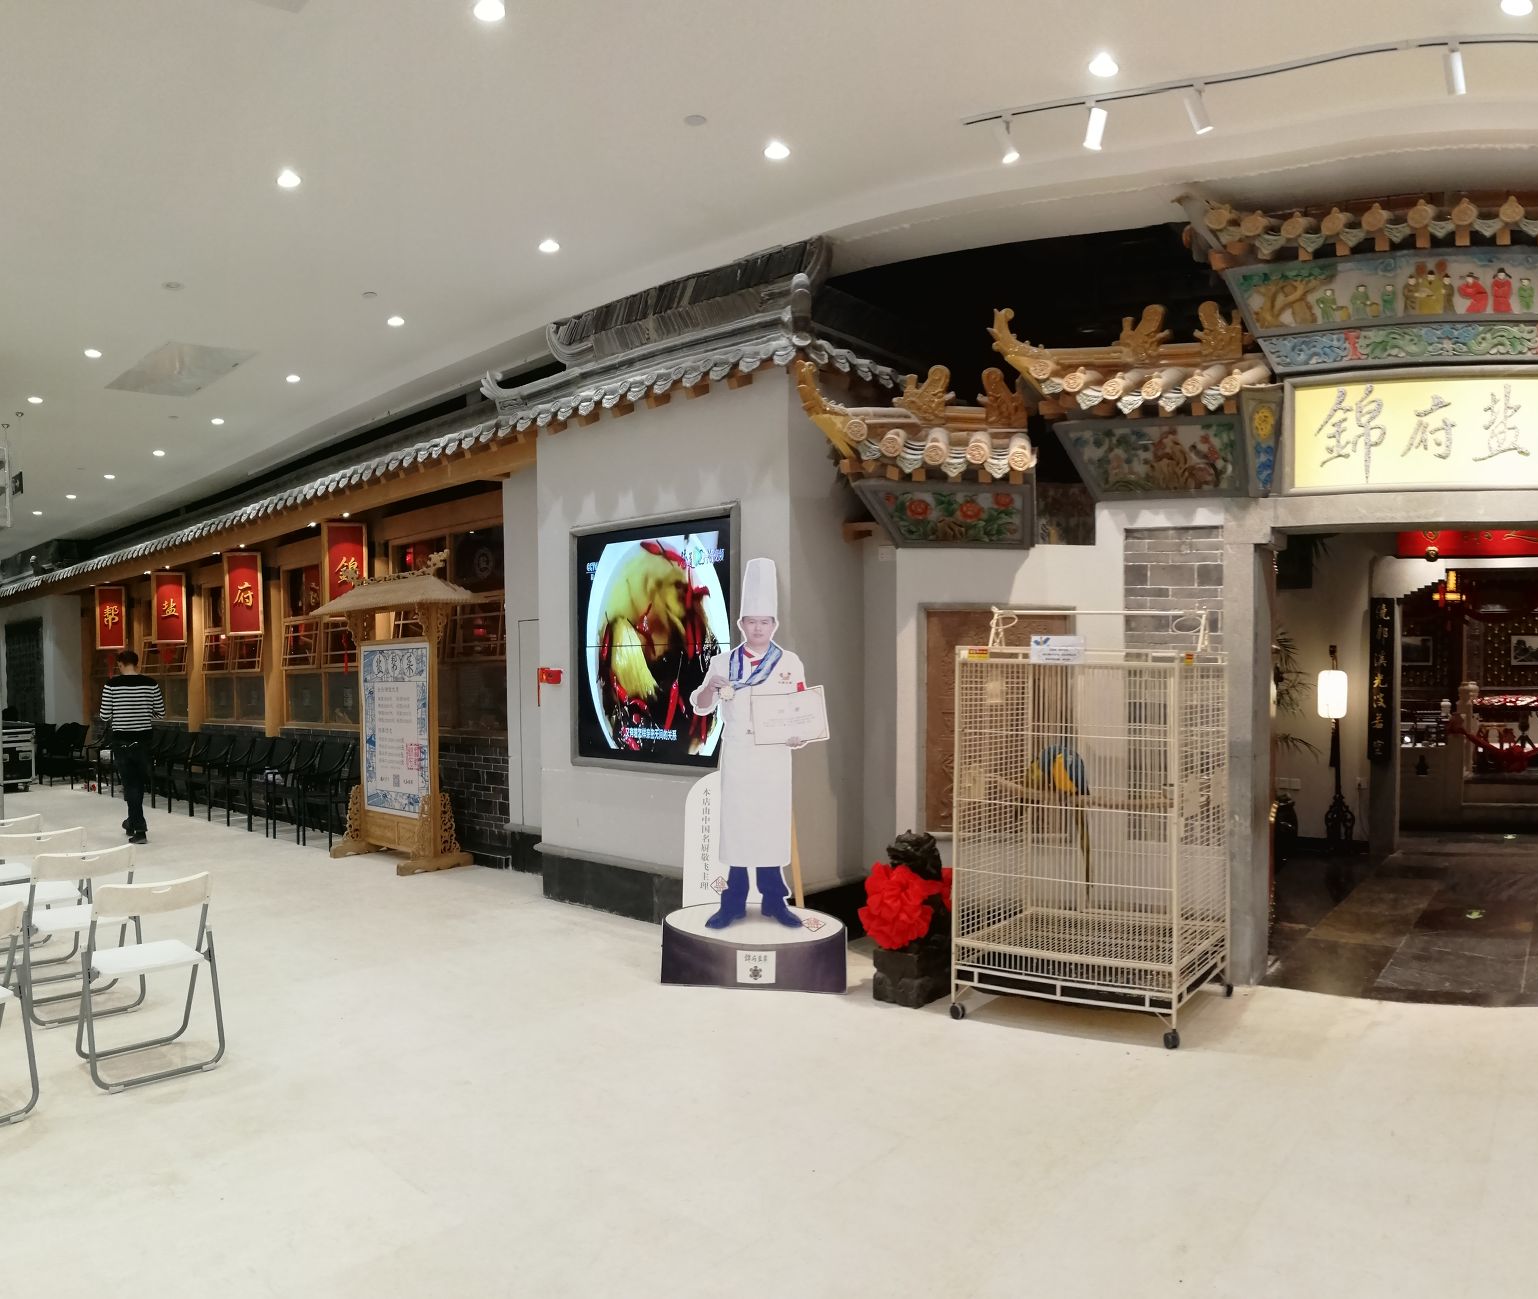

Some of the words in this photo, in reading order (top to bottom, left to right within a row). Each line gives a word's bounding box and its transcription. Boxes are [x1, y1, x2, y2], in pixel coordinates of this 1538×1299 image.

[233, 581, 254, 607] 府
[103, 605, 119, 630] 帮
[161, 598, 179, 617] 盐
